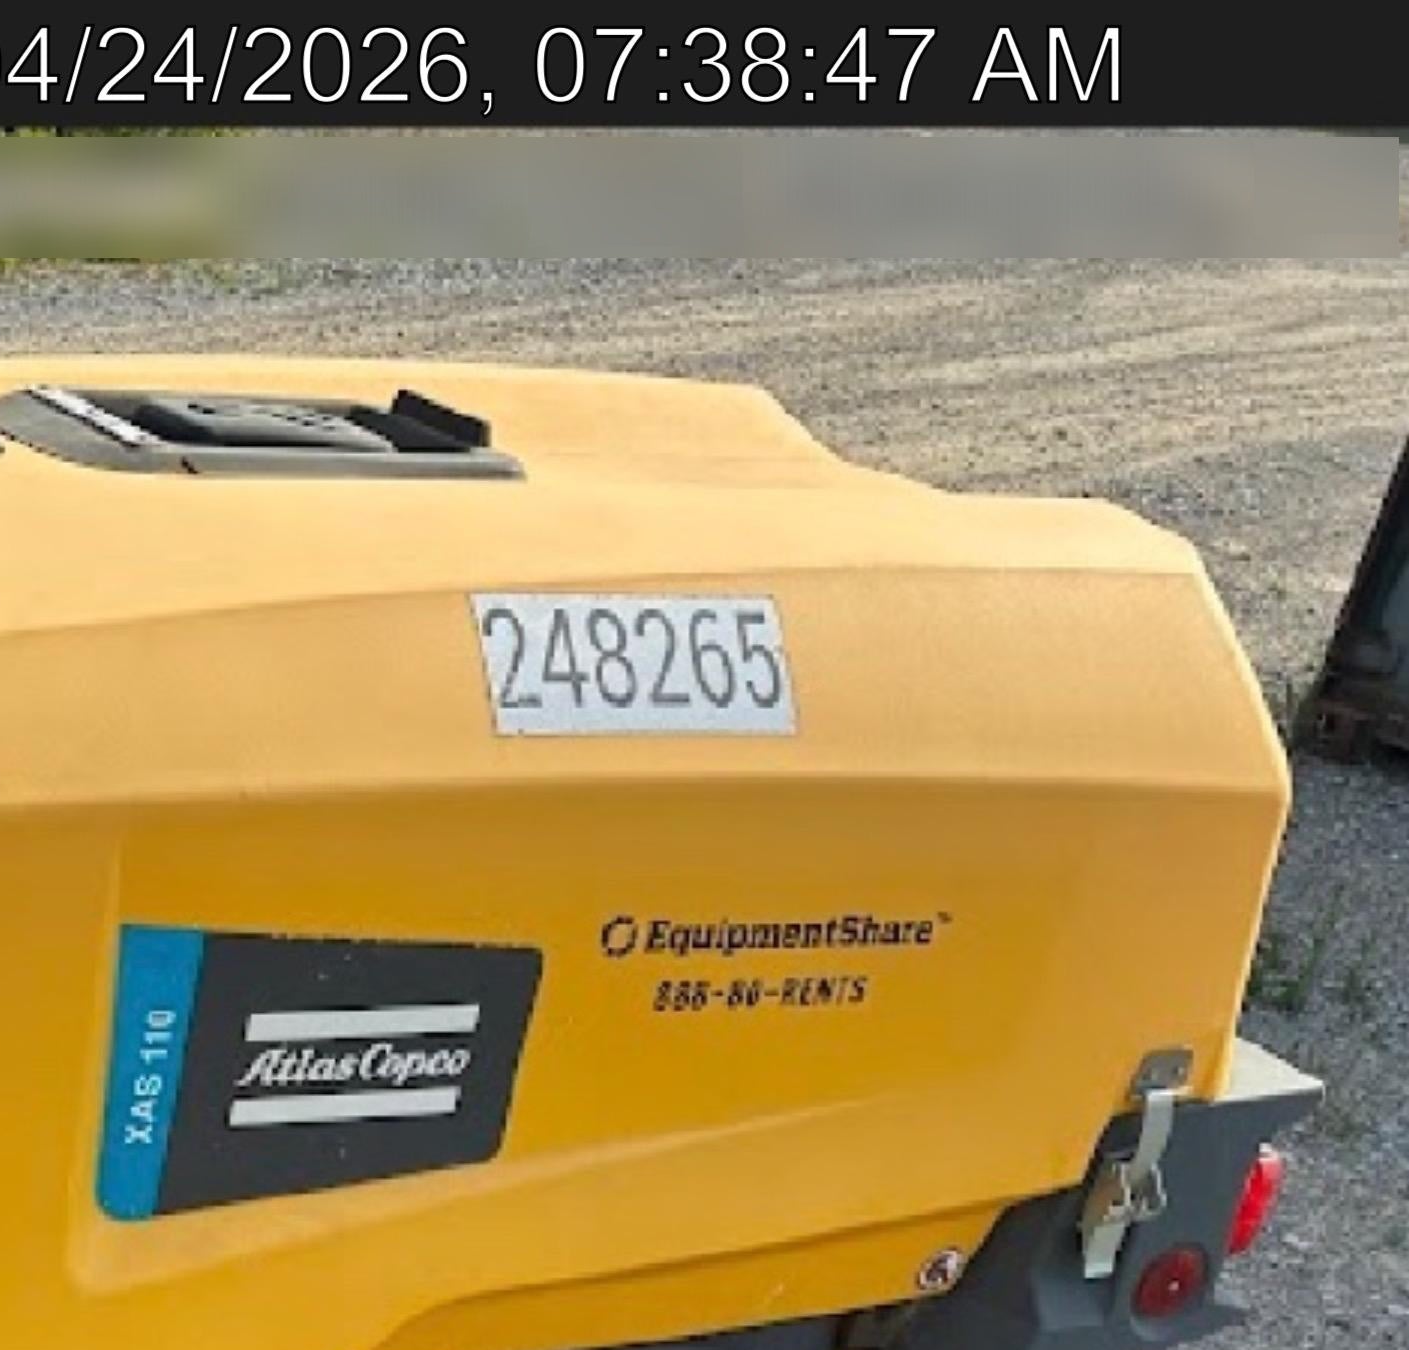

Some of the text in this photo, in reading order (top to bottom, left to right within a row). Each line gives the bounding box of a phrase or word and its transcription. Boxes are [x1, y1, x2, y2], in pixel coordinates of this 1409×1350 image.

[481, 608, 781, 707] 248265
[125, 1009, 177, 1144] XAS 110
[234, 1042, 472, 1087] Atlas Copco
